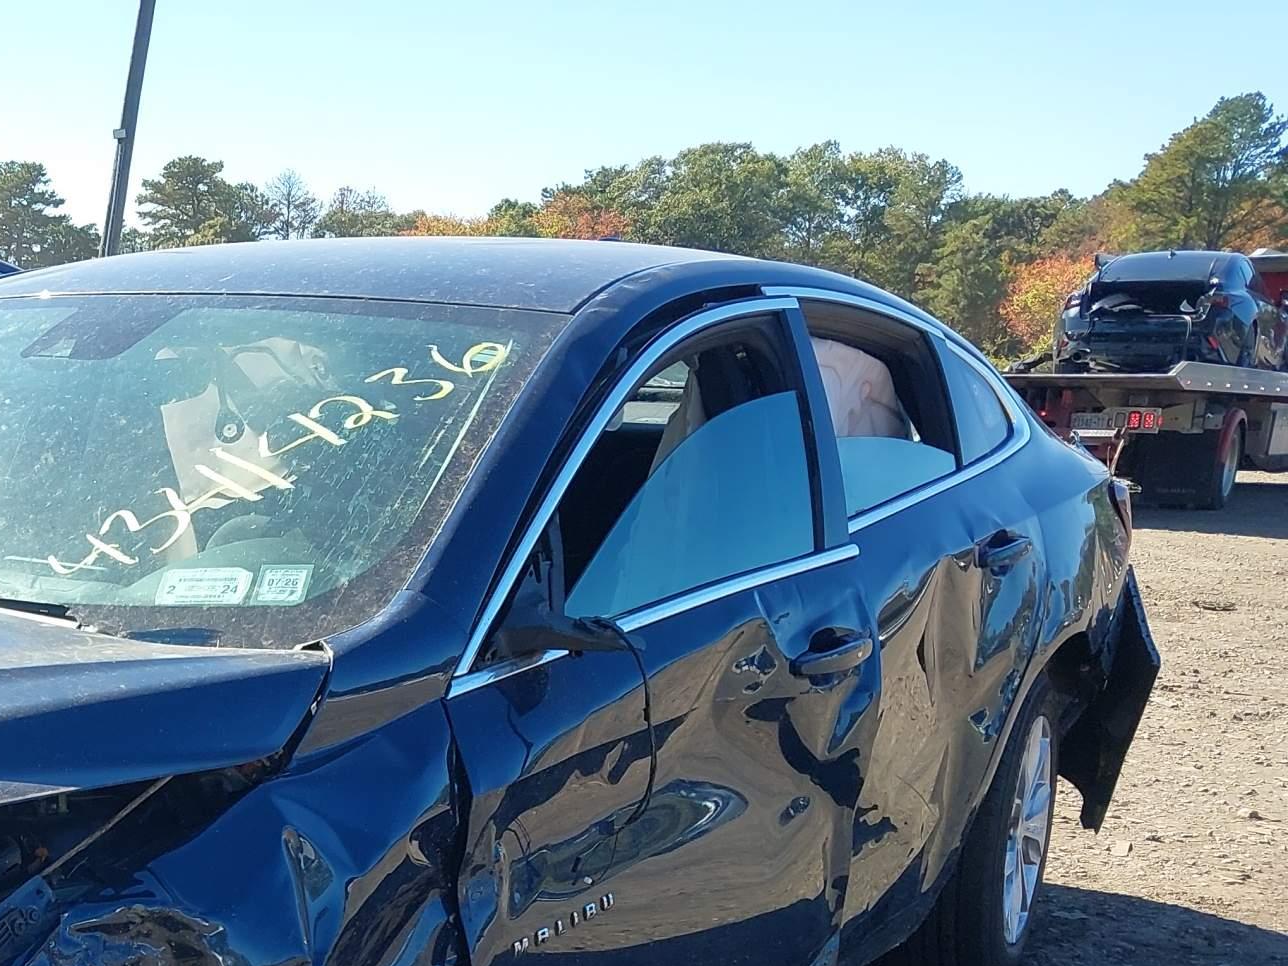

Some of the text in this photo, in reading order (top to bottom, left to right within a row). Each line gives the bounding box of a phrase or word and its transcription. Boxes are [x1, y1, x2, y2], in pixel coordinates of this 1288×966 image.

[166, 585, 176, 595] 2
[220, 584, 239, 595] 24
[513, 893, 615, 957] MALIBU
